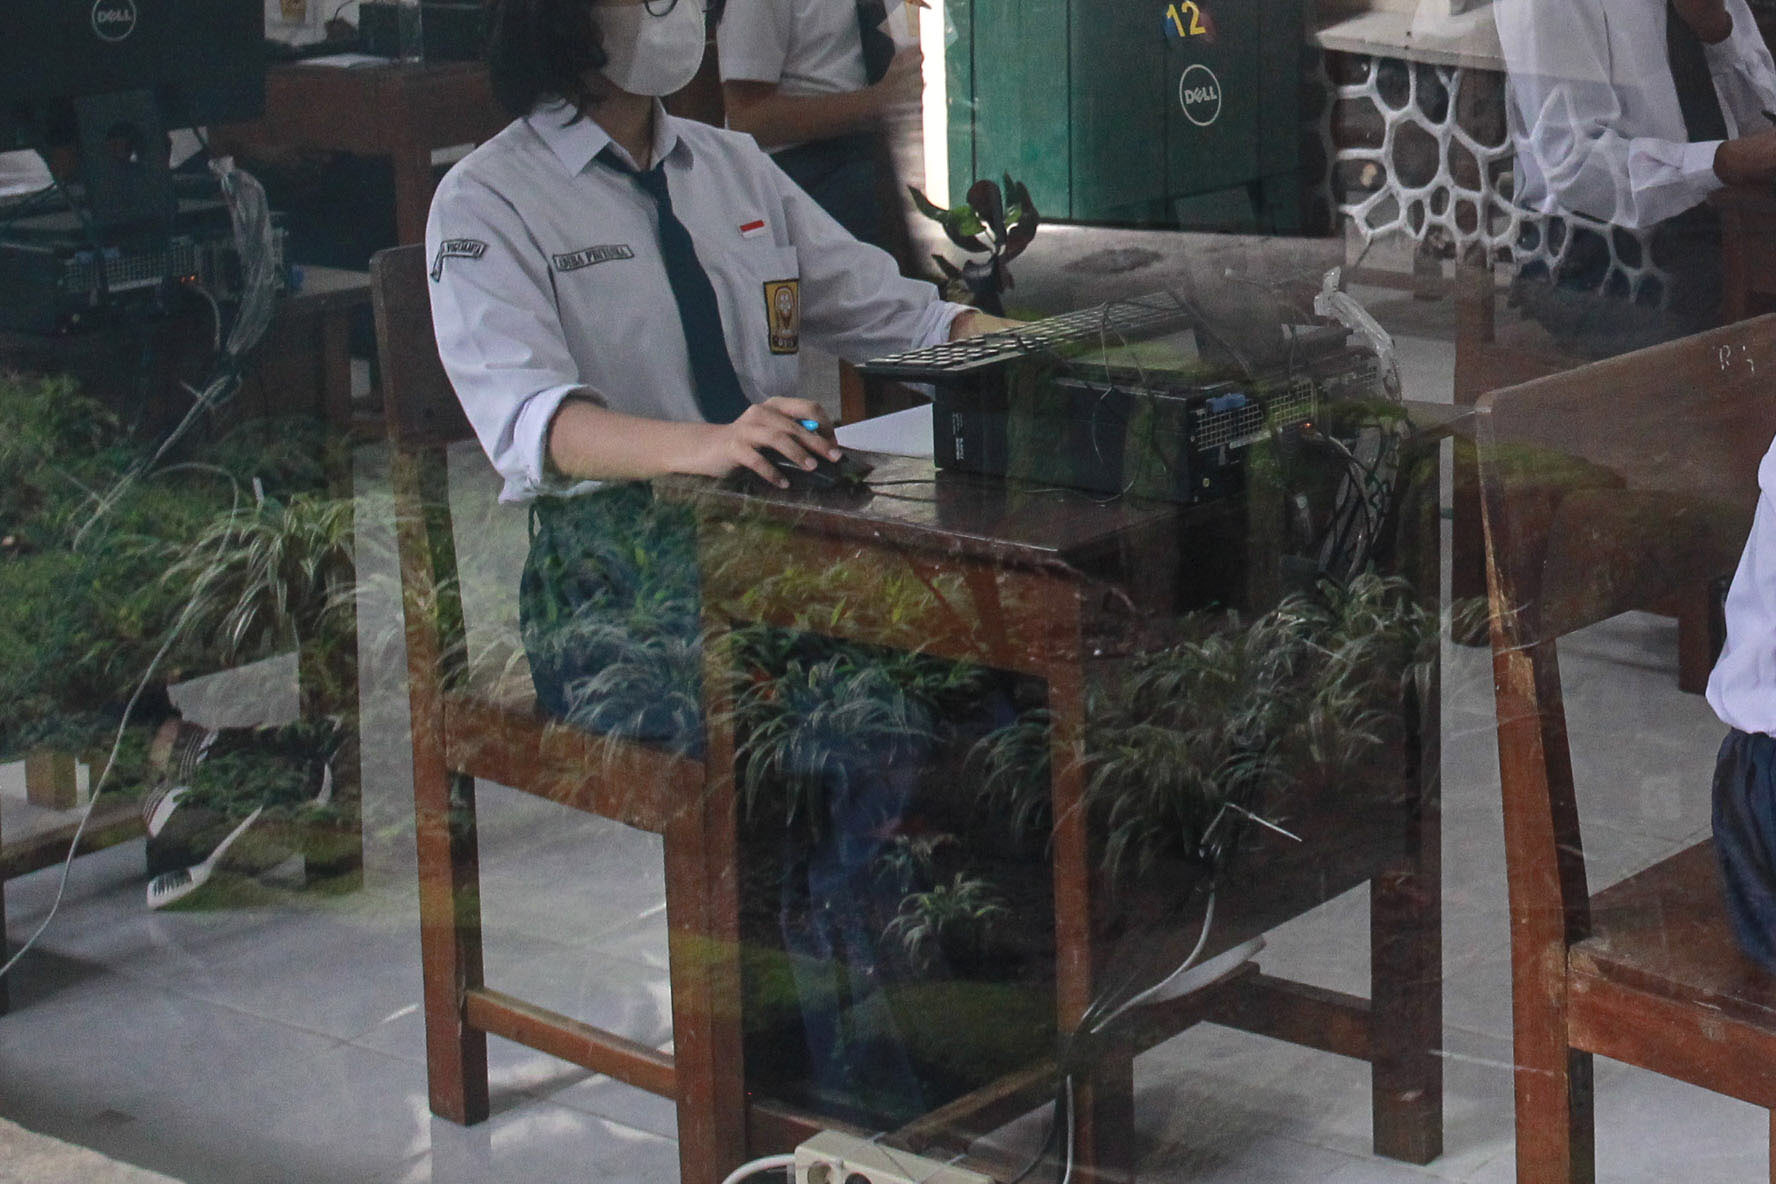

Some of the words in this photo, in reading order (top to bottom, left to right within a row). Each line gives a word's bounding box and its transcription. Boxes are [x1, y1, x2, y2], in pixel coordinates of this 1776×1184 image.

[97, 10, 131, 23] DELL
[1166, 1, 1206, 37] 12
[1184, 86, 1217, 104] DELL
